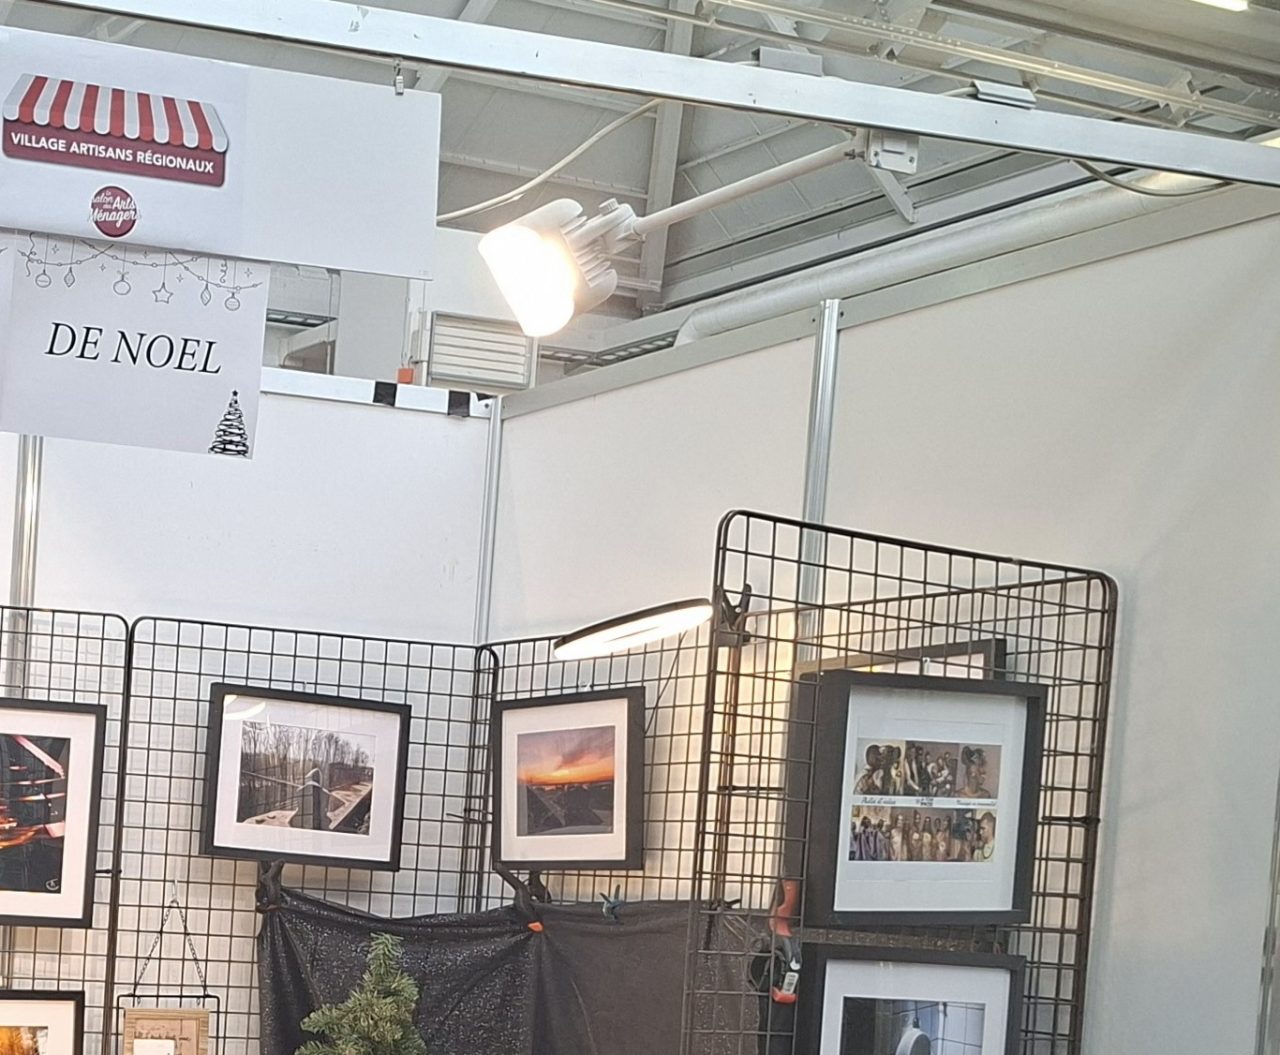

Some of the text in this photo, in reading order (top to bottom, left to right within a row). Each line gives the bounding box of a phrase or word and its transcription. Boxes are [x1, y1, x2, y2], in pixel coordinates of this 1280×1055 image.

[11, 132, 215, 174] VILLAGE ARTISANS RÉGIONAUX
[112, 195, 136, 211] Arts
[44, 321, 222, 374] DE NOEL
